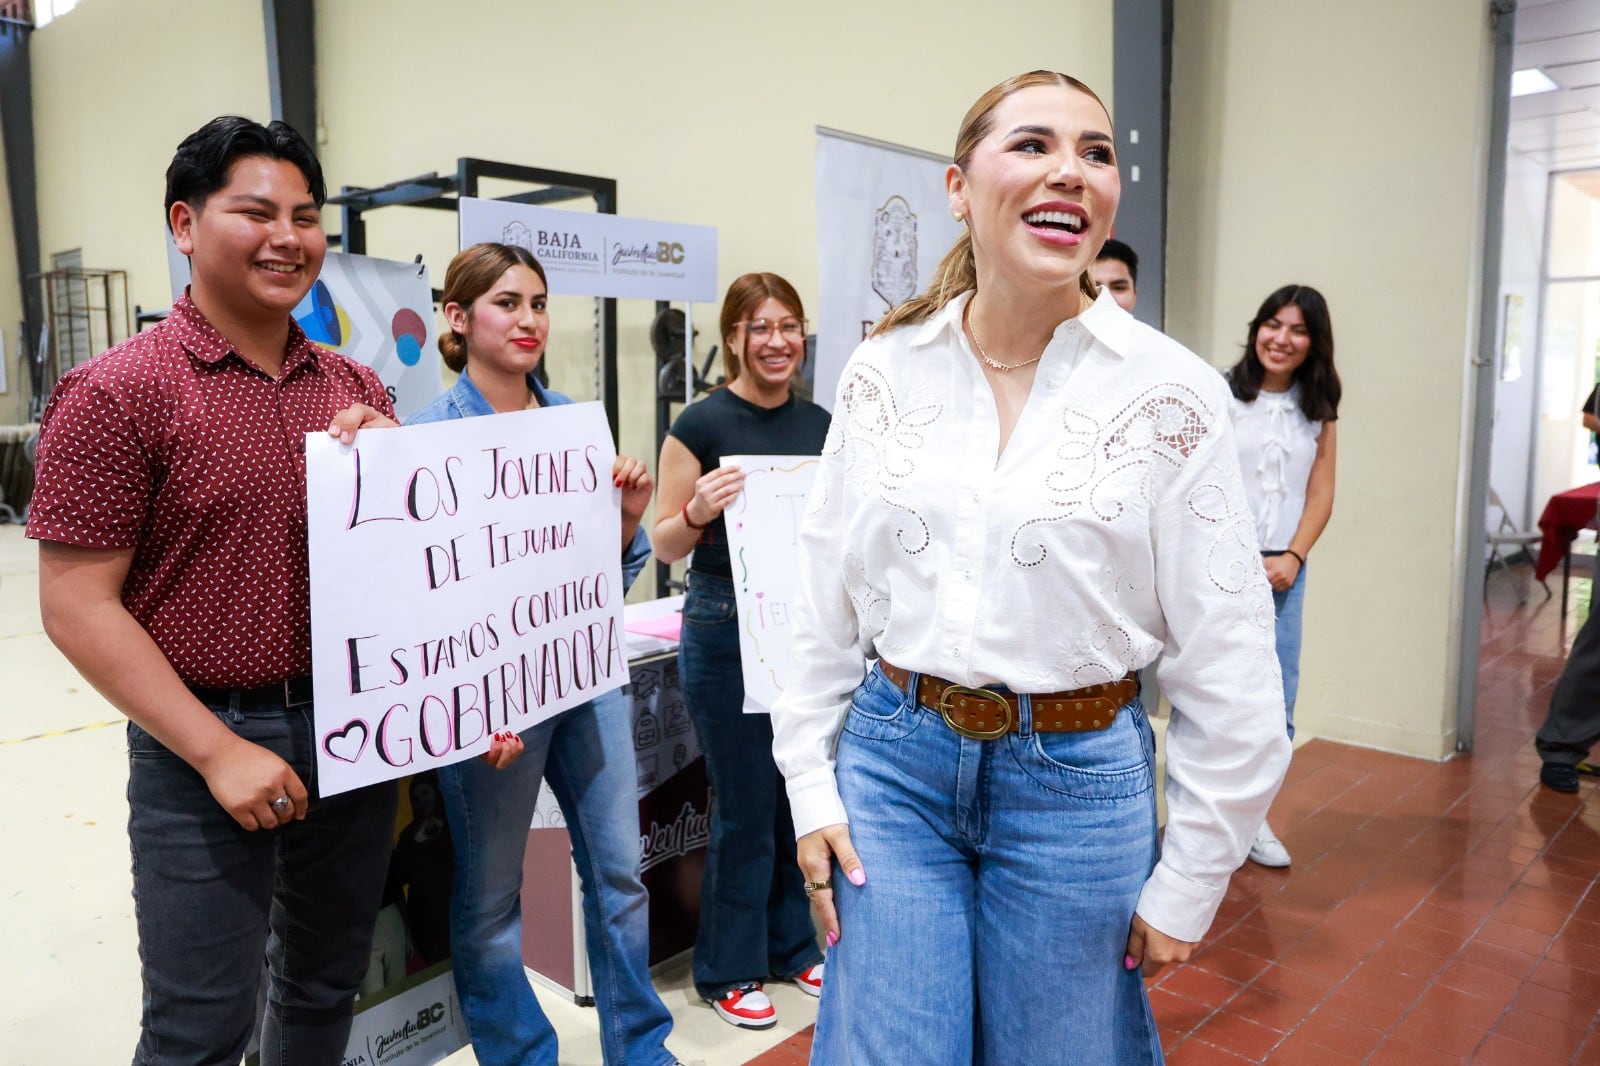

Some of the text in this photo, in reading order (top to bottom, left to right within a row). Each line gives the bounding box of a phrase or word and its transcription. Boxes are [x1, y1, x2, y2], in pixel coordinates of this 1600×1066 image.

[537, 231, 581, 248] BAJA
[537, 248, 598, 261] CALIFORNIA
[345, 444, 598, 531] LOS JOVENES
[424, 521, 575, 591] DE TIJUANA
[345, 572, 609, 696] ESTAMOS CONTIGO
[375, 616, 625, 767] GOBERNADORA
